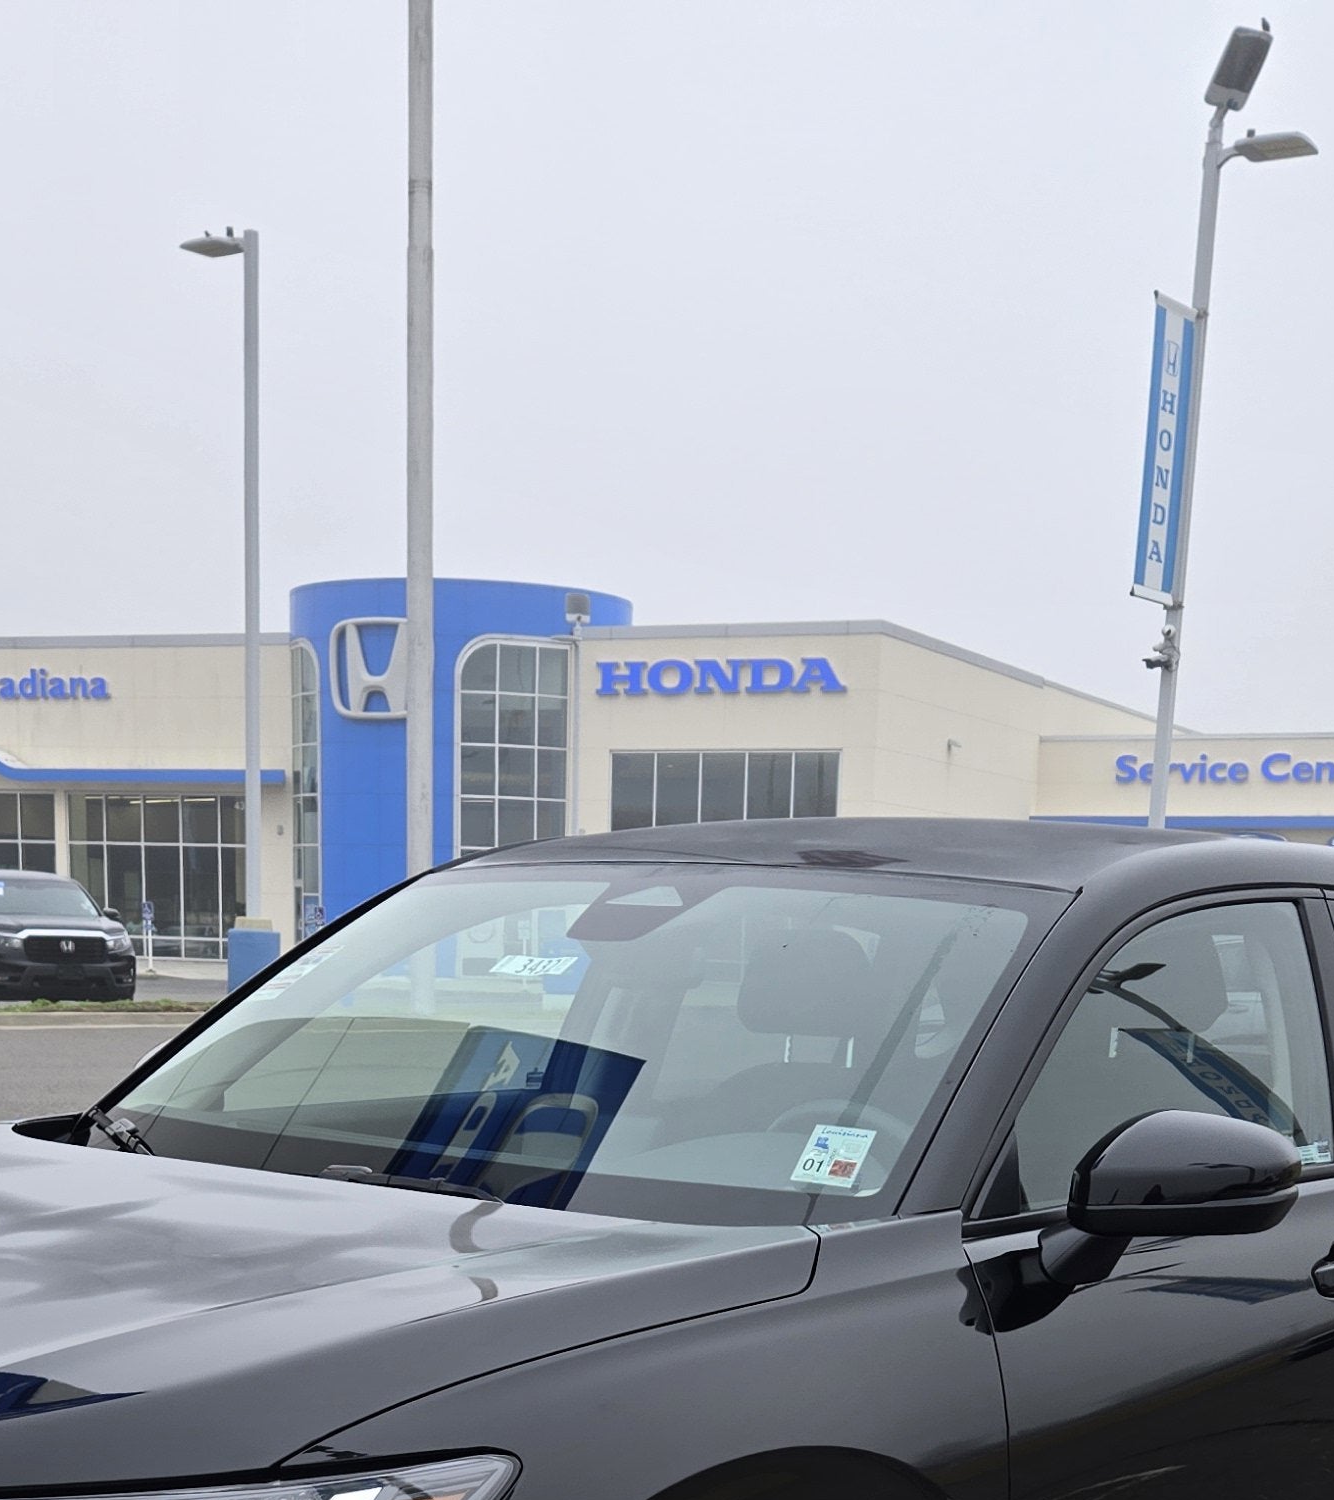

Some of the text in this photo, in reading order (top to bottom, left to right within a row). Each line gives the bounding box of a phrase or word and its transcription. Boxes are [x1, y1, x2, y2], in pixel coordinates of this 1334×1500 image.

[1148, 391, 1176, 563] HONDA
[595, 657, 847, 696] HONDA
[1115, 753, 1249, 784] Service
[802, 1158, 825, 1172] 01
